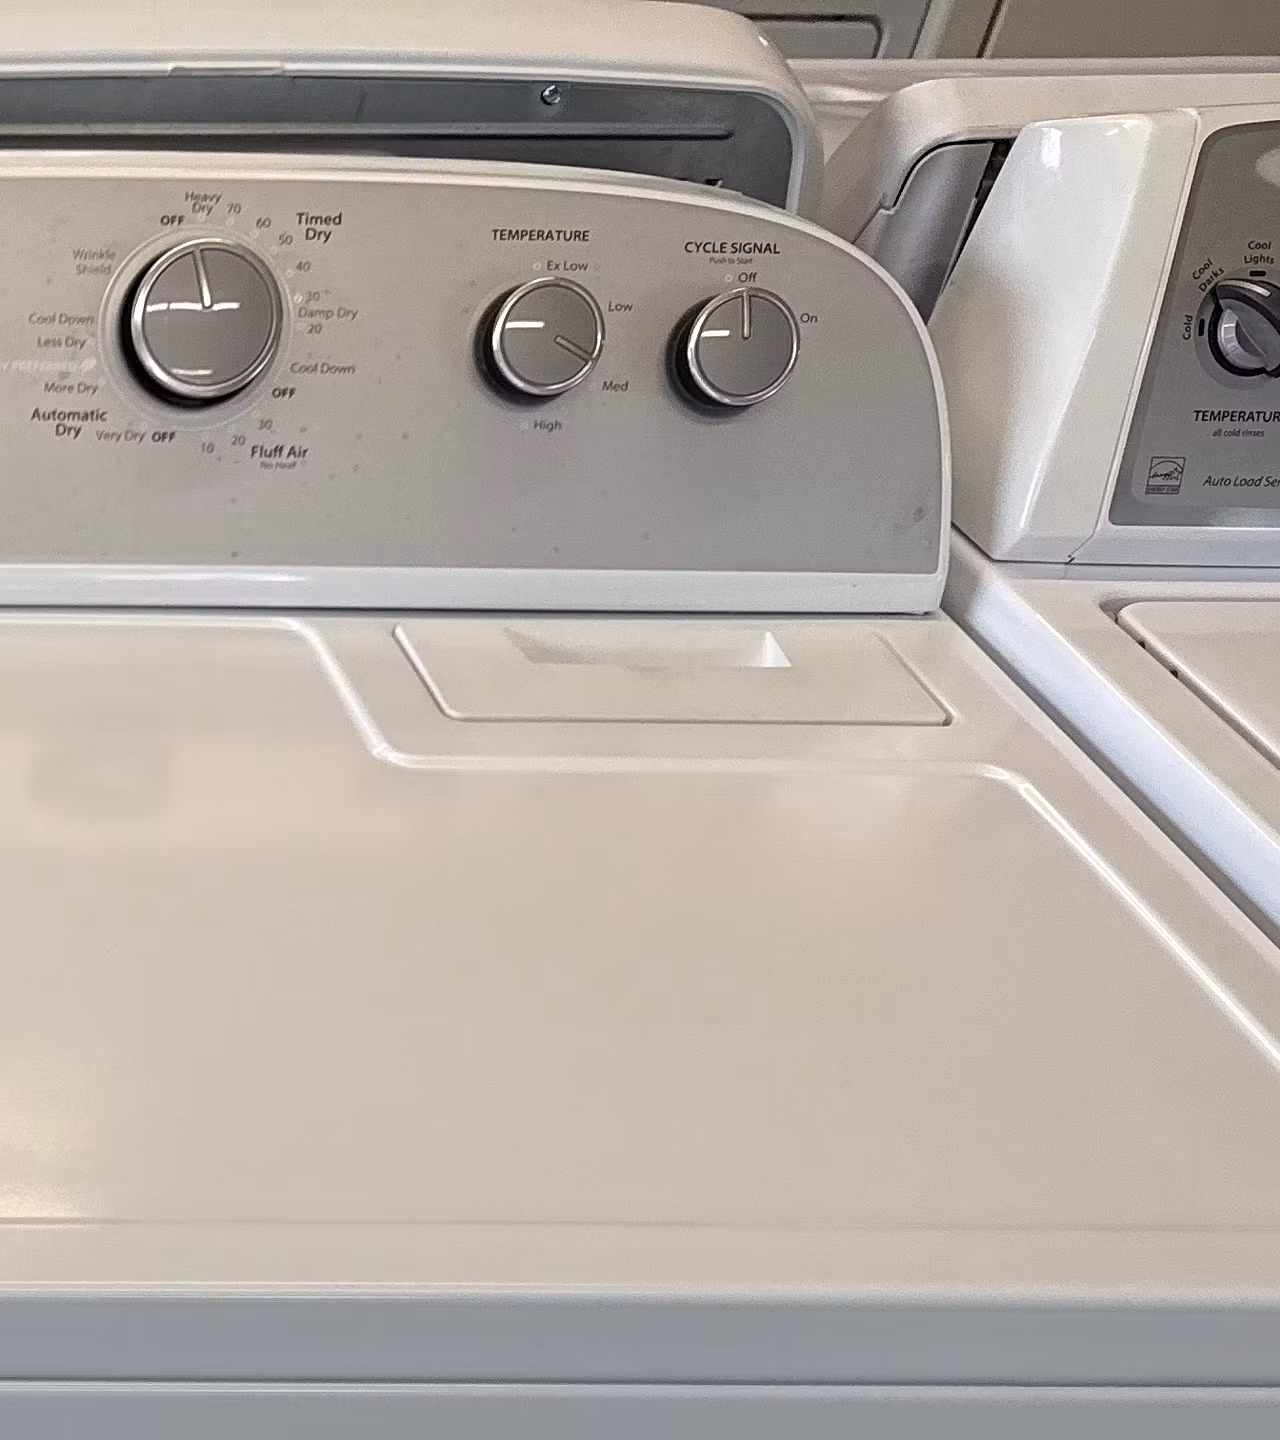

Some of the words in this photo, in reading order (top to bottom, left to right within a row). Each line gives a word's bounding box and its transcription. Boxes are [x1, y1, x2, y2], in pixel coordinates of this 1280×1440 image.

[185, 191, 222, 205] Heavy
[192, 203, 214, 216] Dry
[227, 203, 242, 214] 70
[160, 215, 185, 226] OFF
[256, 217, 272, 228] 60
[296, 212, 343, 226] Timed
[305, 228, 332, 244] Dry
[491, 229, 590, 241] TEMPERATURE
[684, 242, 727, 254] CYCLE
[730, 242, 780, 254] SIGNAL
[1248, 240, 1272, 250] Cool
[547, 261, 560, 271] Ex
[563, 261, 589, 271] Low
[1243, 255, 1275, 265] Lights
[296, 261, 311, 272] 40
[1192, 258, 1214, 280] Cool
[738, 272, 758, 283] Off
[1198, 267, 1225, 293] Darks
[608, 301, 633, 312] Low
[28, 312, 57, 325] Cool
[298, 308, 334, 320] Damp
[336, 307, 358, 320] Dry
[800, 312, 818, 323] On
[307, 323, 322, 334] 20
[1182, 314, 1194, 341] Cold
[37, 336, 62, 348] Less
[64, 336, 87, 350] Dry
[291, 362, 318, 375] Cool
[43, 382, 74, 395] More
[77, 382, 99, 396] Dry
[602, 381, 629, 392] Med
[272, 387, 296, 399] OFF
[31, 407, 108, 422] Automatic
[55, 423, 82, 439] Dry
[533, 419, 562, 431] High
[95, 430, 122, 443] Very
[124, 430, 146, 443] Dry
[151, 431, 177, 443] OFF
[1212, 428, 1223, 437] all
[1223, 428, 1241, 437] cold
[1242, 429, 1265, 437] rinses
[231, 435, 246, 446] 20
[201, 443, 215, 454] 10
[250, 445, 284, 459] Fluff
[286, 445, 309, 459] Air
[1202, 475, 1232, 487] Auto
[1233, 475, 1264, 487] Load
